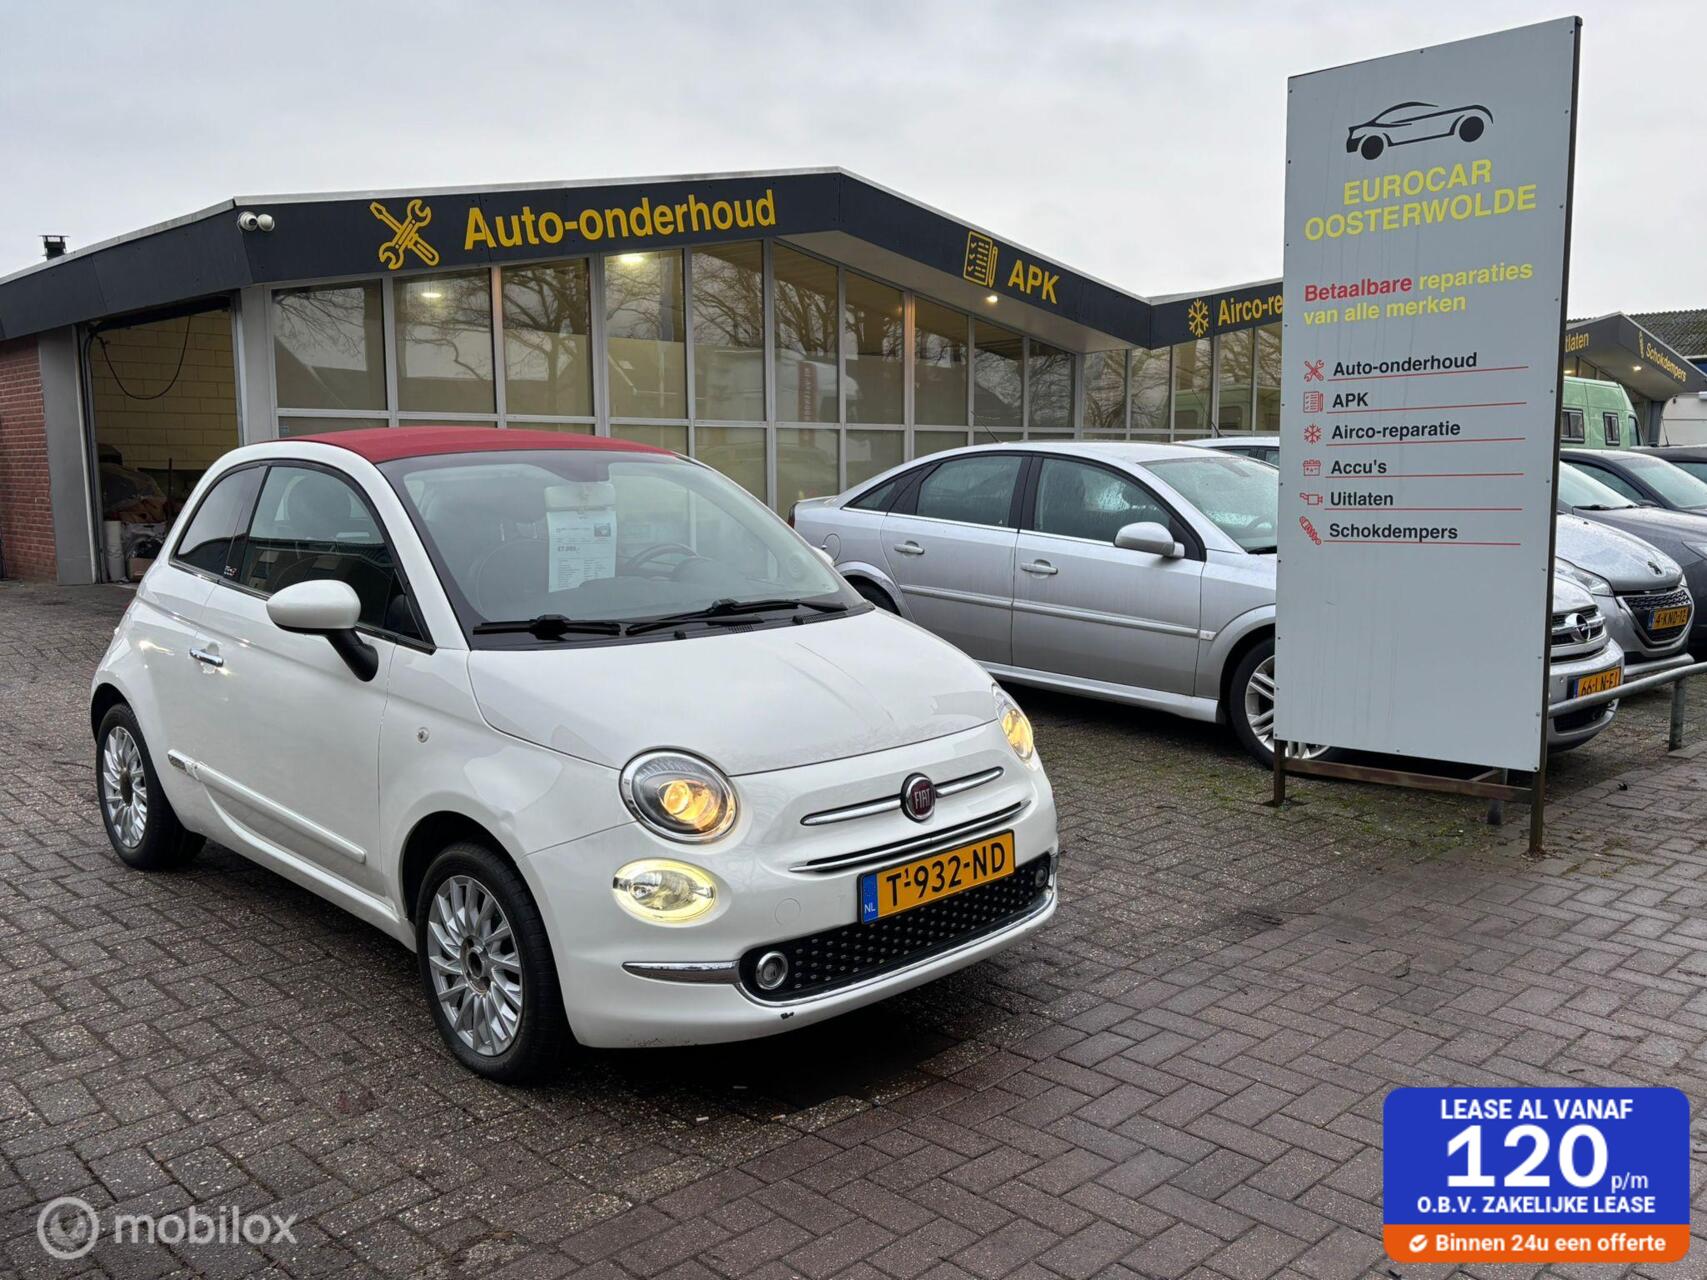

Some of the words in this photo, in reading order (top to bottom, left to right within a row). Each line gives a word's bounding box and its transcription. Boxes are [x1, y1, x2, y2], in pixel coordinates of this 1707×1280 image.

[1343, 159, 1492, 205] EUROCAR
[463, 189, 777, 251] Auto-onderhoud
[1304, 184, 1537, 241] OOSTERWOLDE
[1007, 258, 1061, 304] APK
[1304, 277, 1412, 302] Betaalbare
[1418, 262, 1533, 291] reparaties
[1217, 294, 1283, 326] Airco-re
[1304, 307, 1338, 326] van
[1344, 301, 1380, 322] alle
[1386, 294, 1467, 318] merken
[1333, 352, 1477, 376] Auto-onderhoud
[1646, 342, 1687, 382] Schokdempers
[1332, 392, 1369, 408] APK
[1331, 421, 1461, 440] Airco-reparatie
[1330, 460, 1388, 475] Accu's
[1330, 492, 1395, 506] Uitlaten
[1329, 523, 1459, 543] Schokdempers
[914, 787, 931, 809] FIAT
[864, 902, 876, 913] NL
